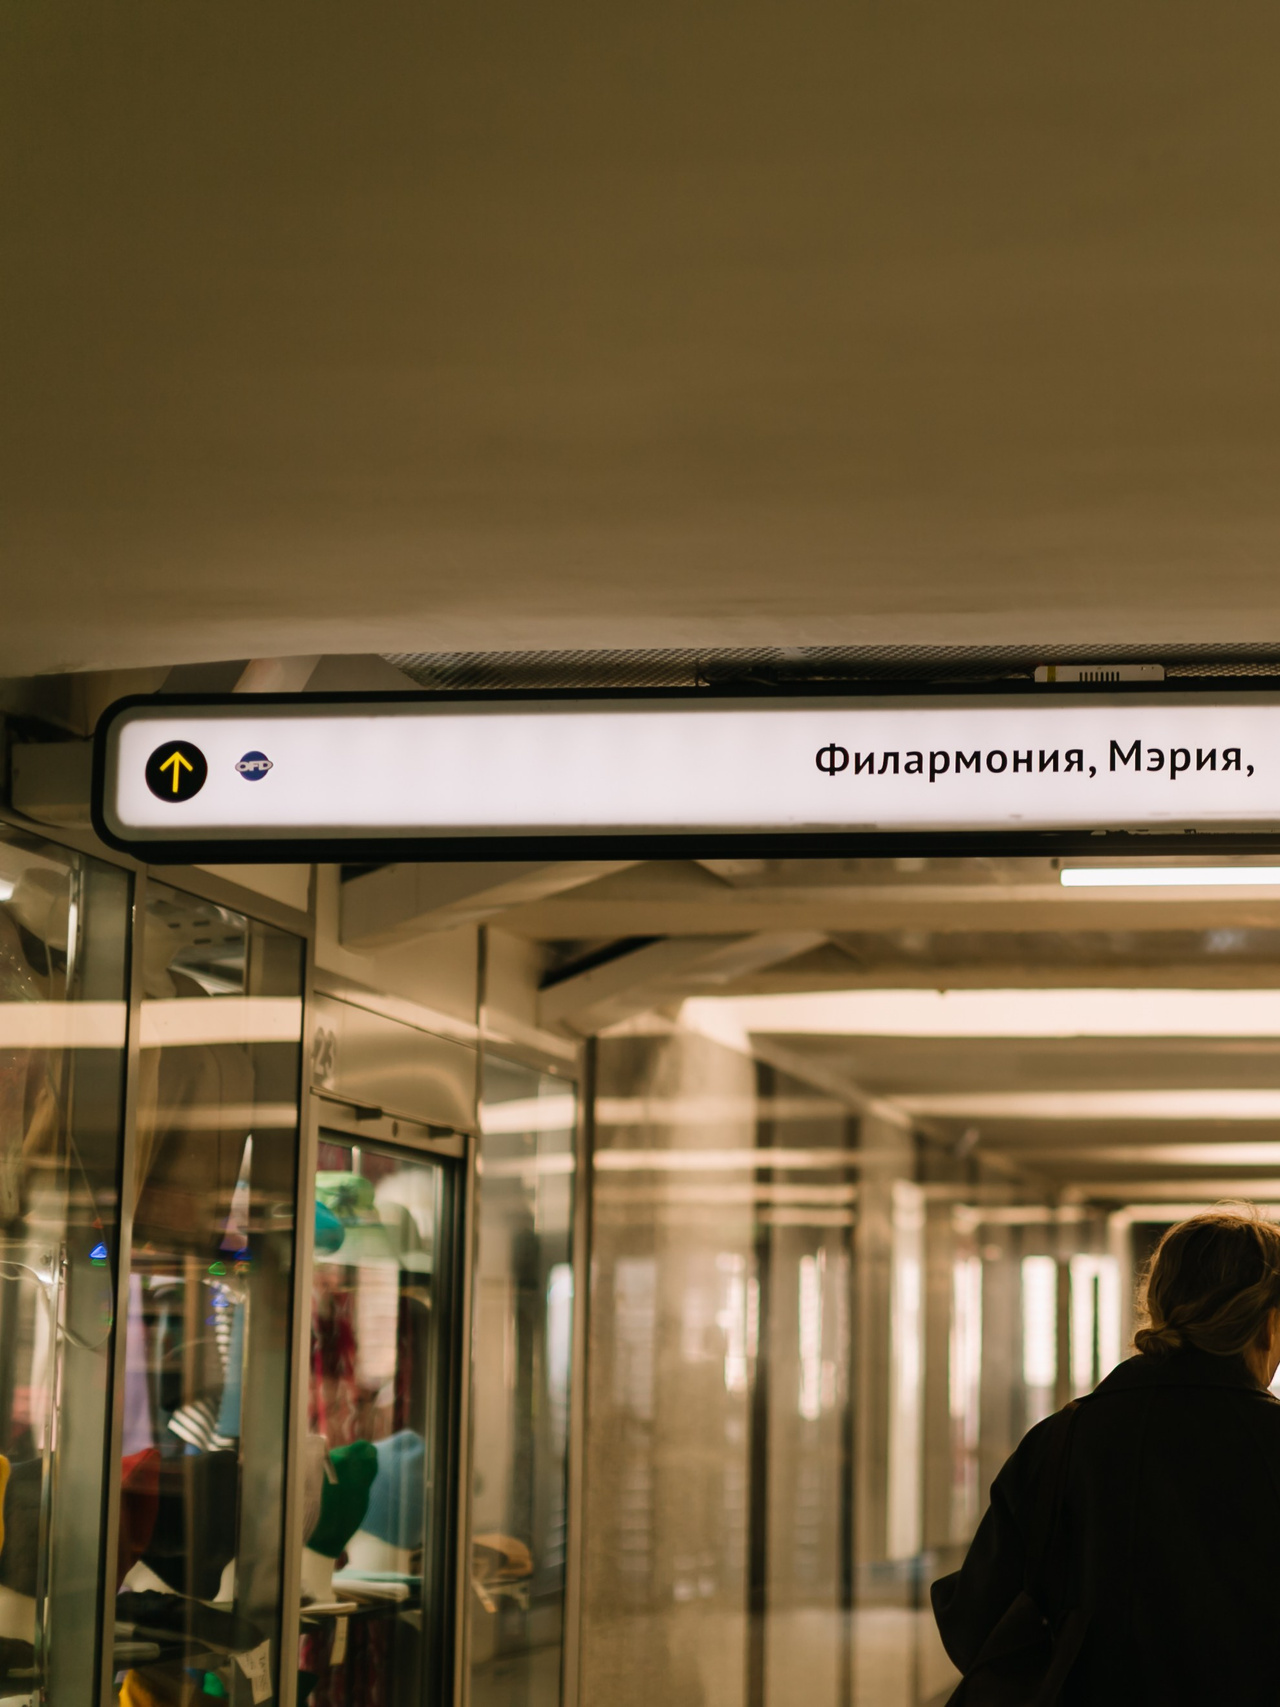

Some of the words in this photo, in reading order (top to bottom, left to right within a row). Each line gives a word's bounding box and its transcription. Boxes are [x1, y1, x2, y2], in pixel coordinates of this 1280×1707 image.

[235, 760, 273, 772] OFD
[816, 742, 1098, 783] Филармония,
[1109, 739, 1256, 781] Мэрия,
